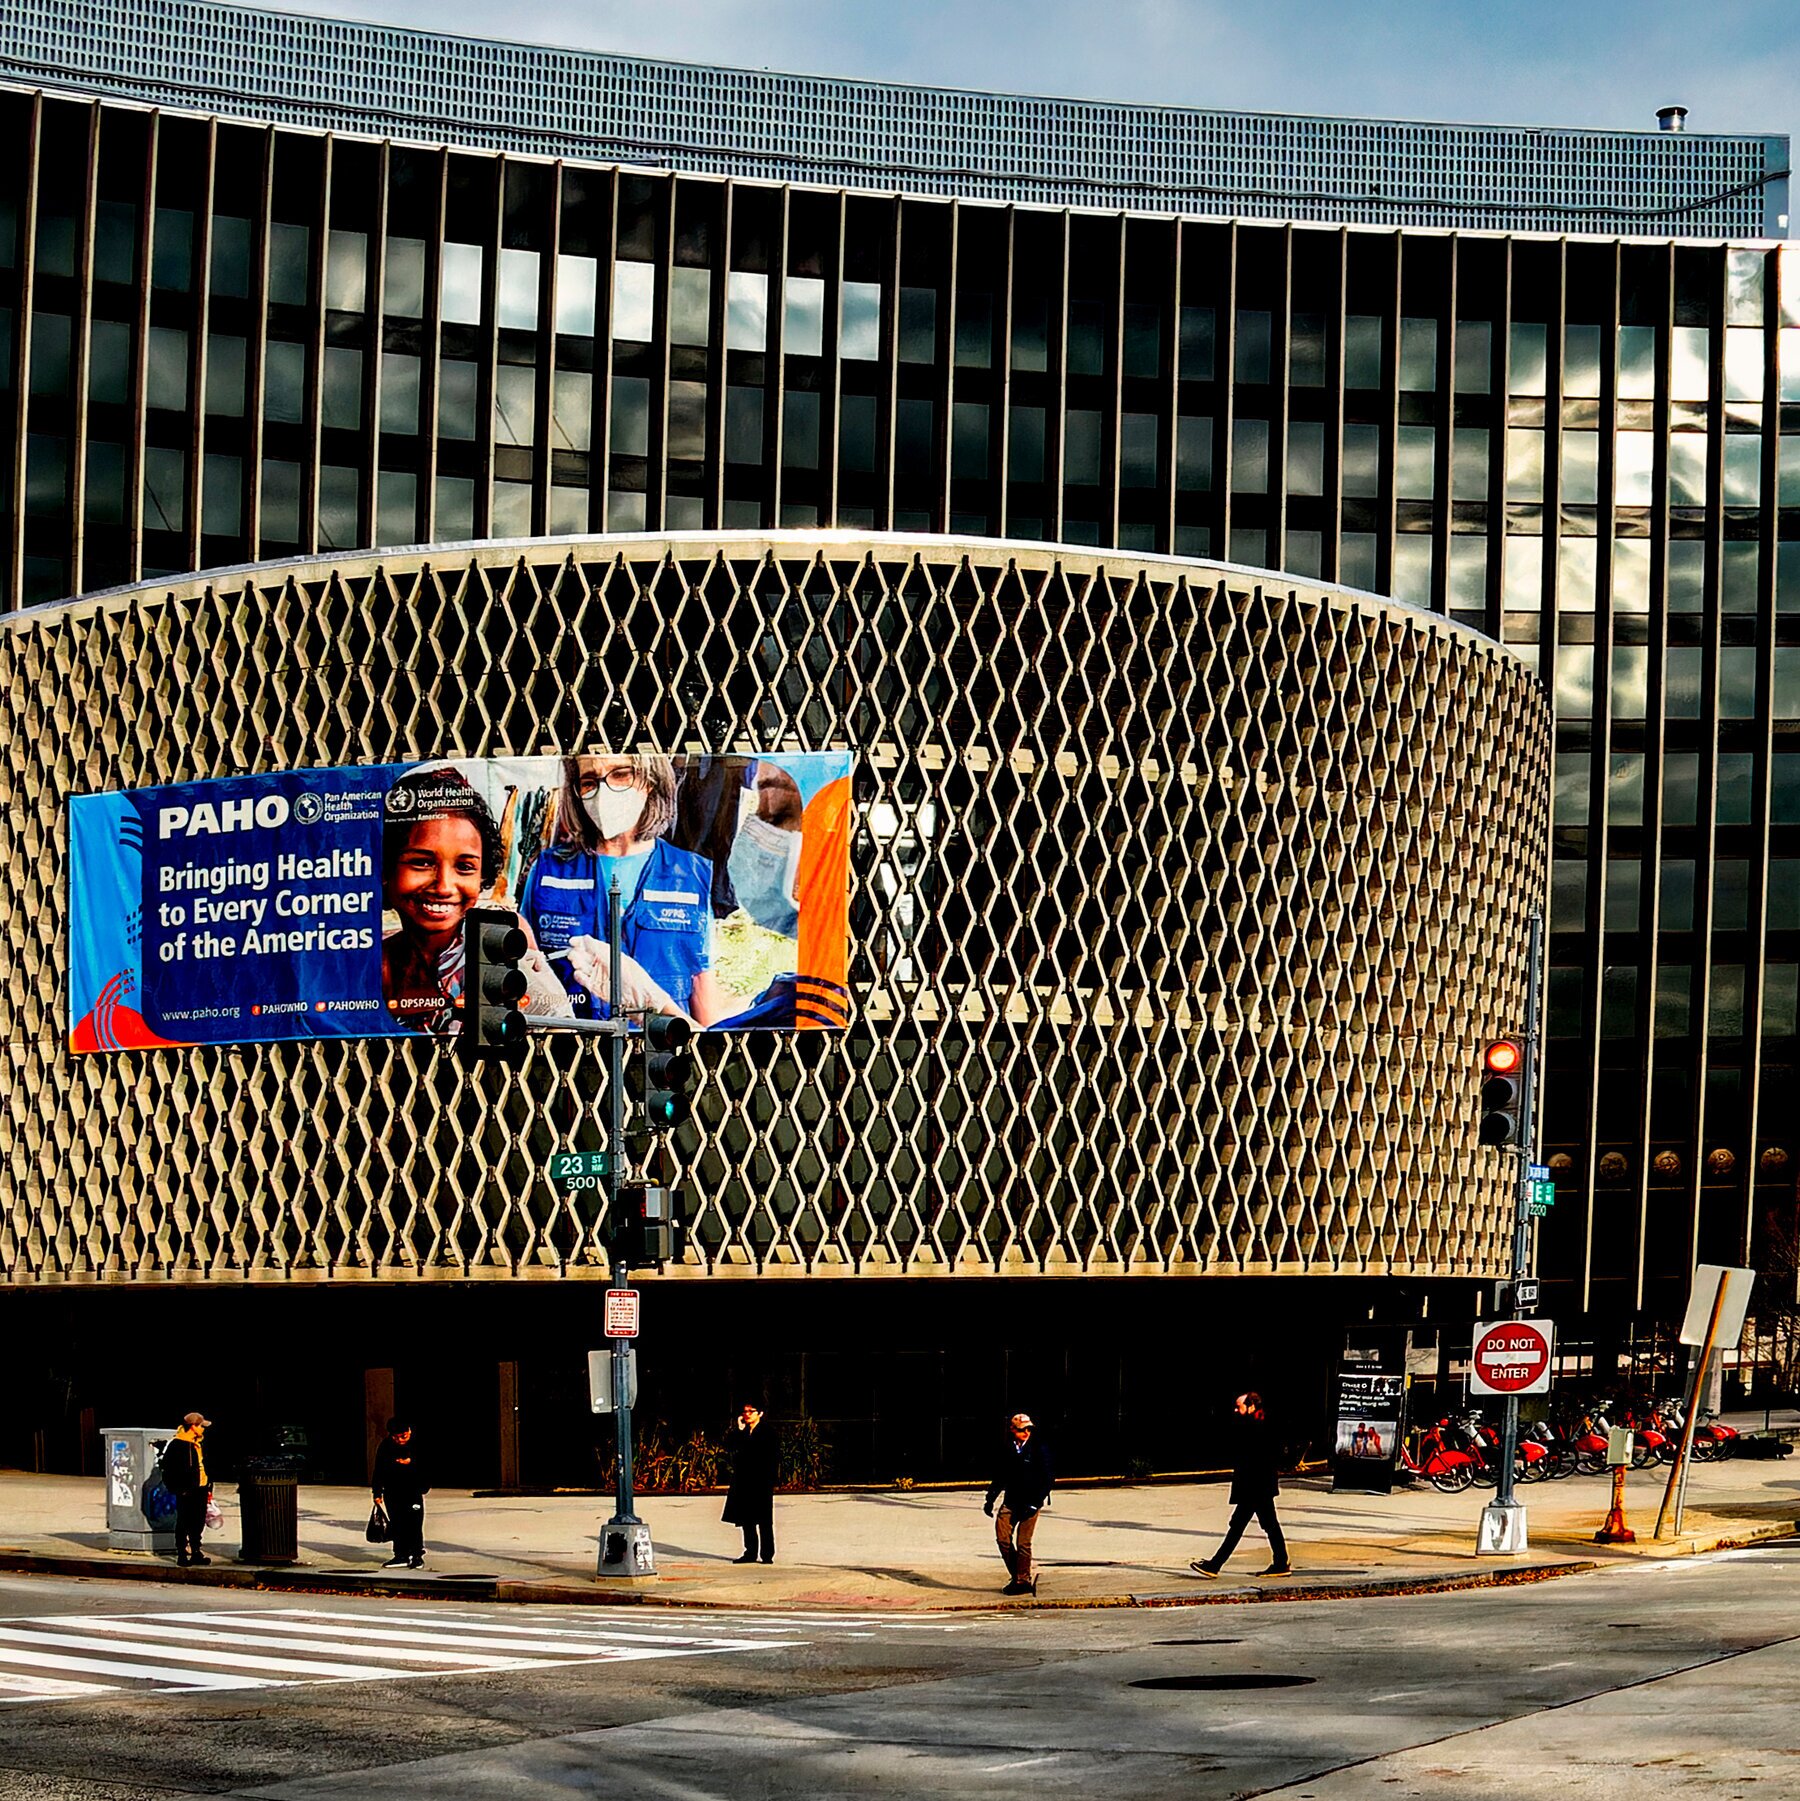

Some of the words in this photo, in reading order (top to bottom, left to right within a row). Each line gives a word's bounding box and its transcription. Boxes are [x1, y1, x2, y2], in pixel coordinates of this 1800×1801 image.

[324, 793, 340, 801] Pan
[341, 790, 382, 801] American
[417, 787, 443, 799] World
[445, 785, 474, 797] Health
[324, 802, 353, 811] Health
[417, 795, 474, 811] Organization
[159, 795, 290, 840] PAHO
[324, 810, 379, 823] Organization
[159, 857, 269, 894] Bringing
[277, 848, 372, 881] Health
[158, 902, 186, 927] to
[193, 897, 268, 927] Every
[275, 889, 374, 917] Corner
[159, 932, 187, 962] of
[191, 931, 236, 959] the
[241, 922, 374, 955] Americas
[262, 1001, 308, 1014] PAHOWHO
[328, 999, 379, 1011] PAHOWHO
[400, 997, 445, 1008] OPSPAHO
[161, 1006, 241, 1021] www.paho.org
[560, 1156, 583, 1175] 23
[591, 1154, 602, 1164] ST
[566, 1175, 596, 1190] 500
[1535, 1184, 1543, 1201] E
[1487, 1339, 1506, 1350] DO
[1510, 1338, 1536, 1350] NOT
[1491, 1367, 1529, 1379] ENTER
